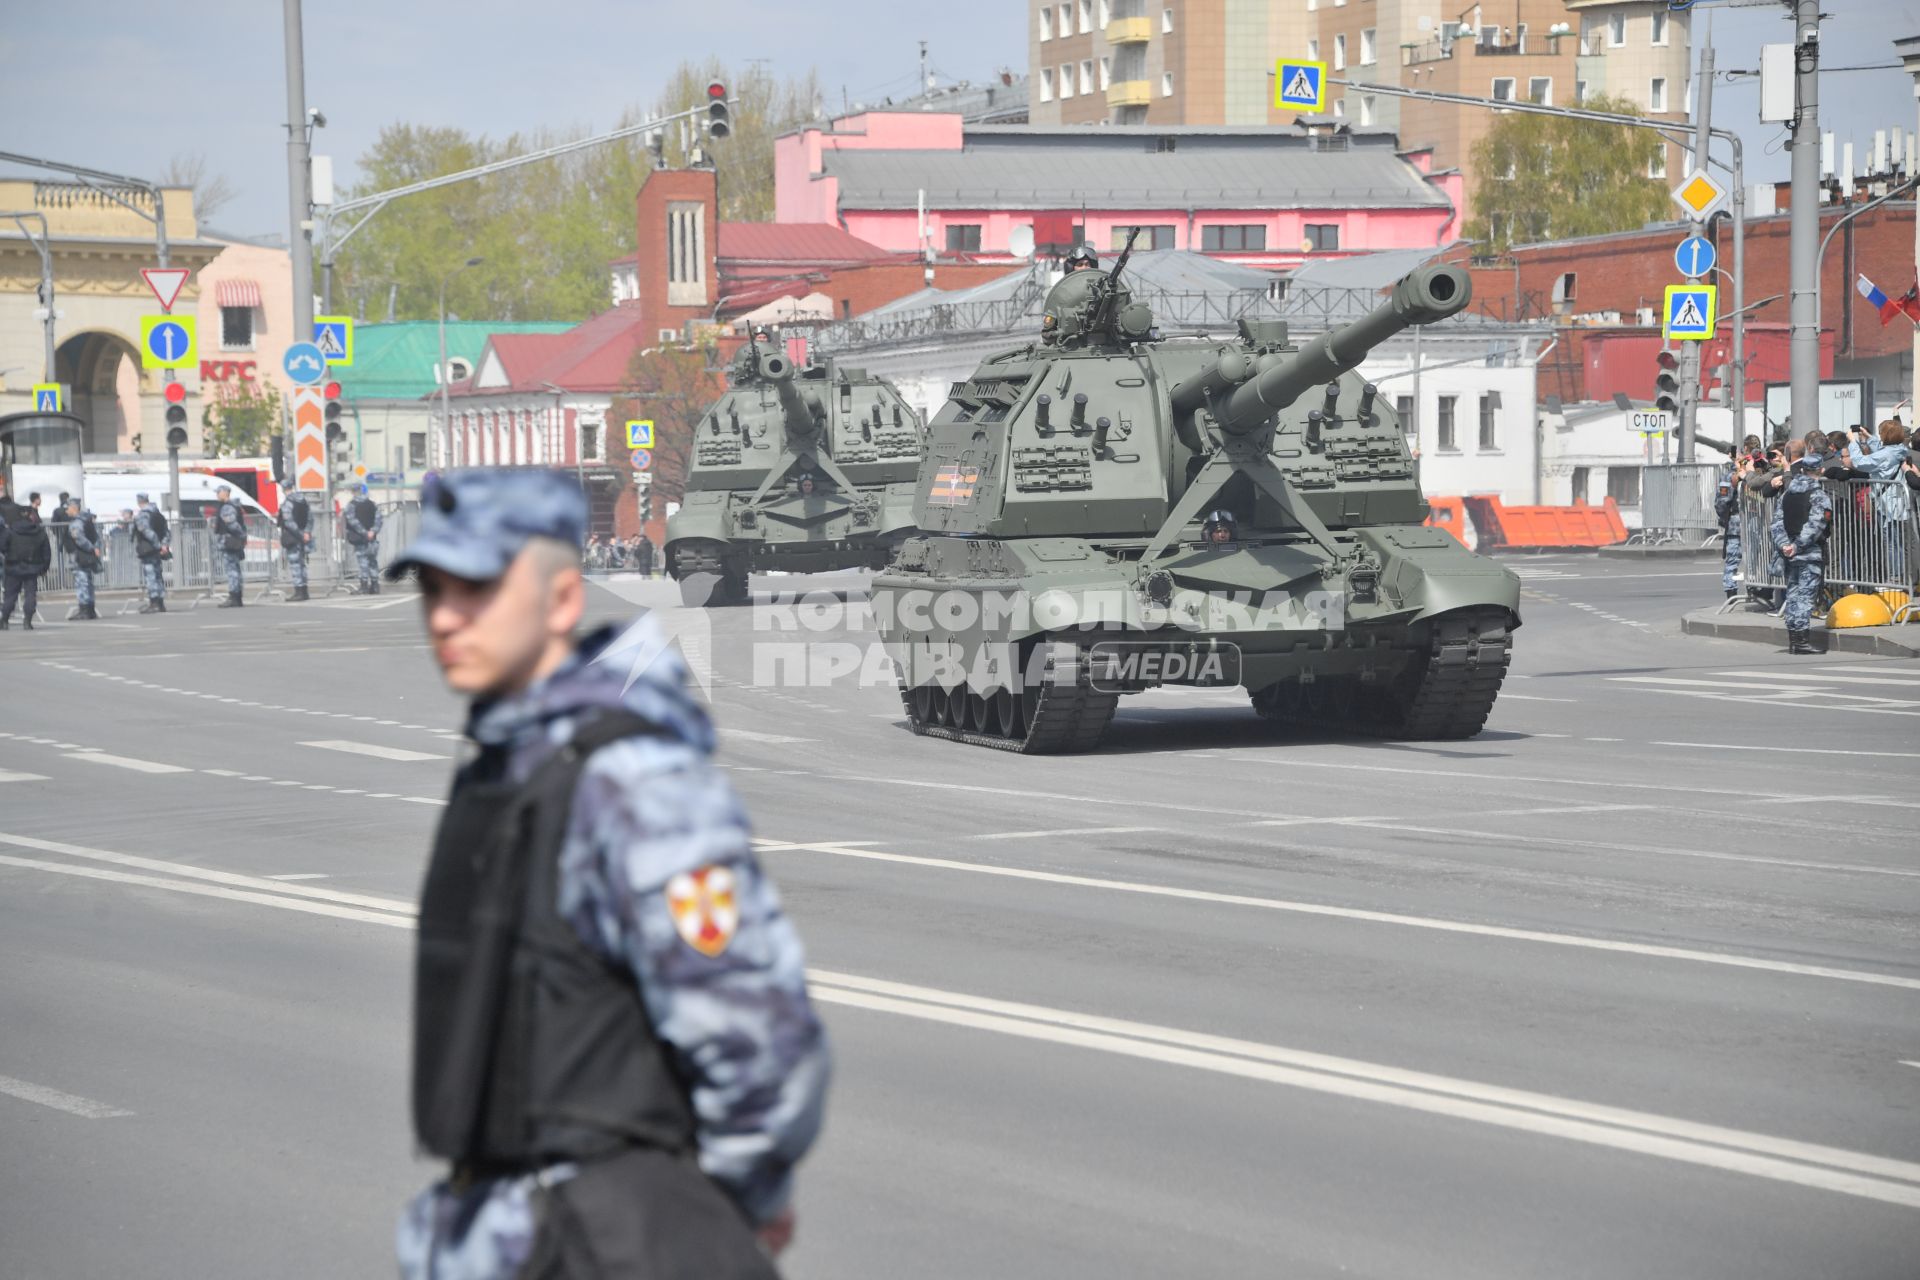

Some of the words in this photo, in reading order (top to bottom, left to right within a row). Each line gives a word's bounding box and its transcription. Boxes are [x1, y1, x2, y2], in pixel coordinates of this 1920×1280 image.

[200, 360, 256, 382] KFC
[1834, 389, 1856, 399] LIME
[1633, 413, 1666, 428] СТОП
